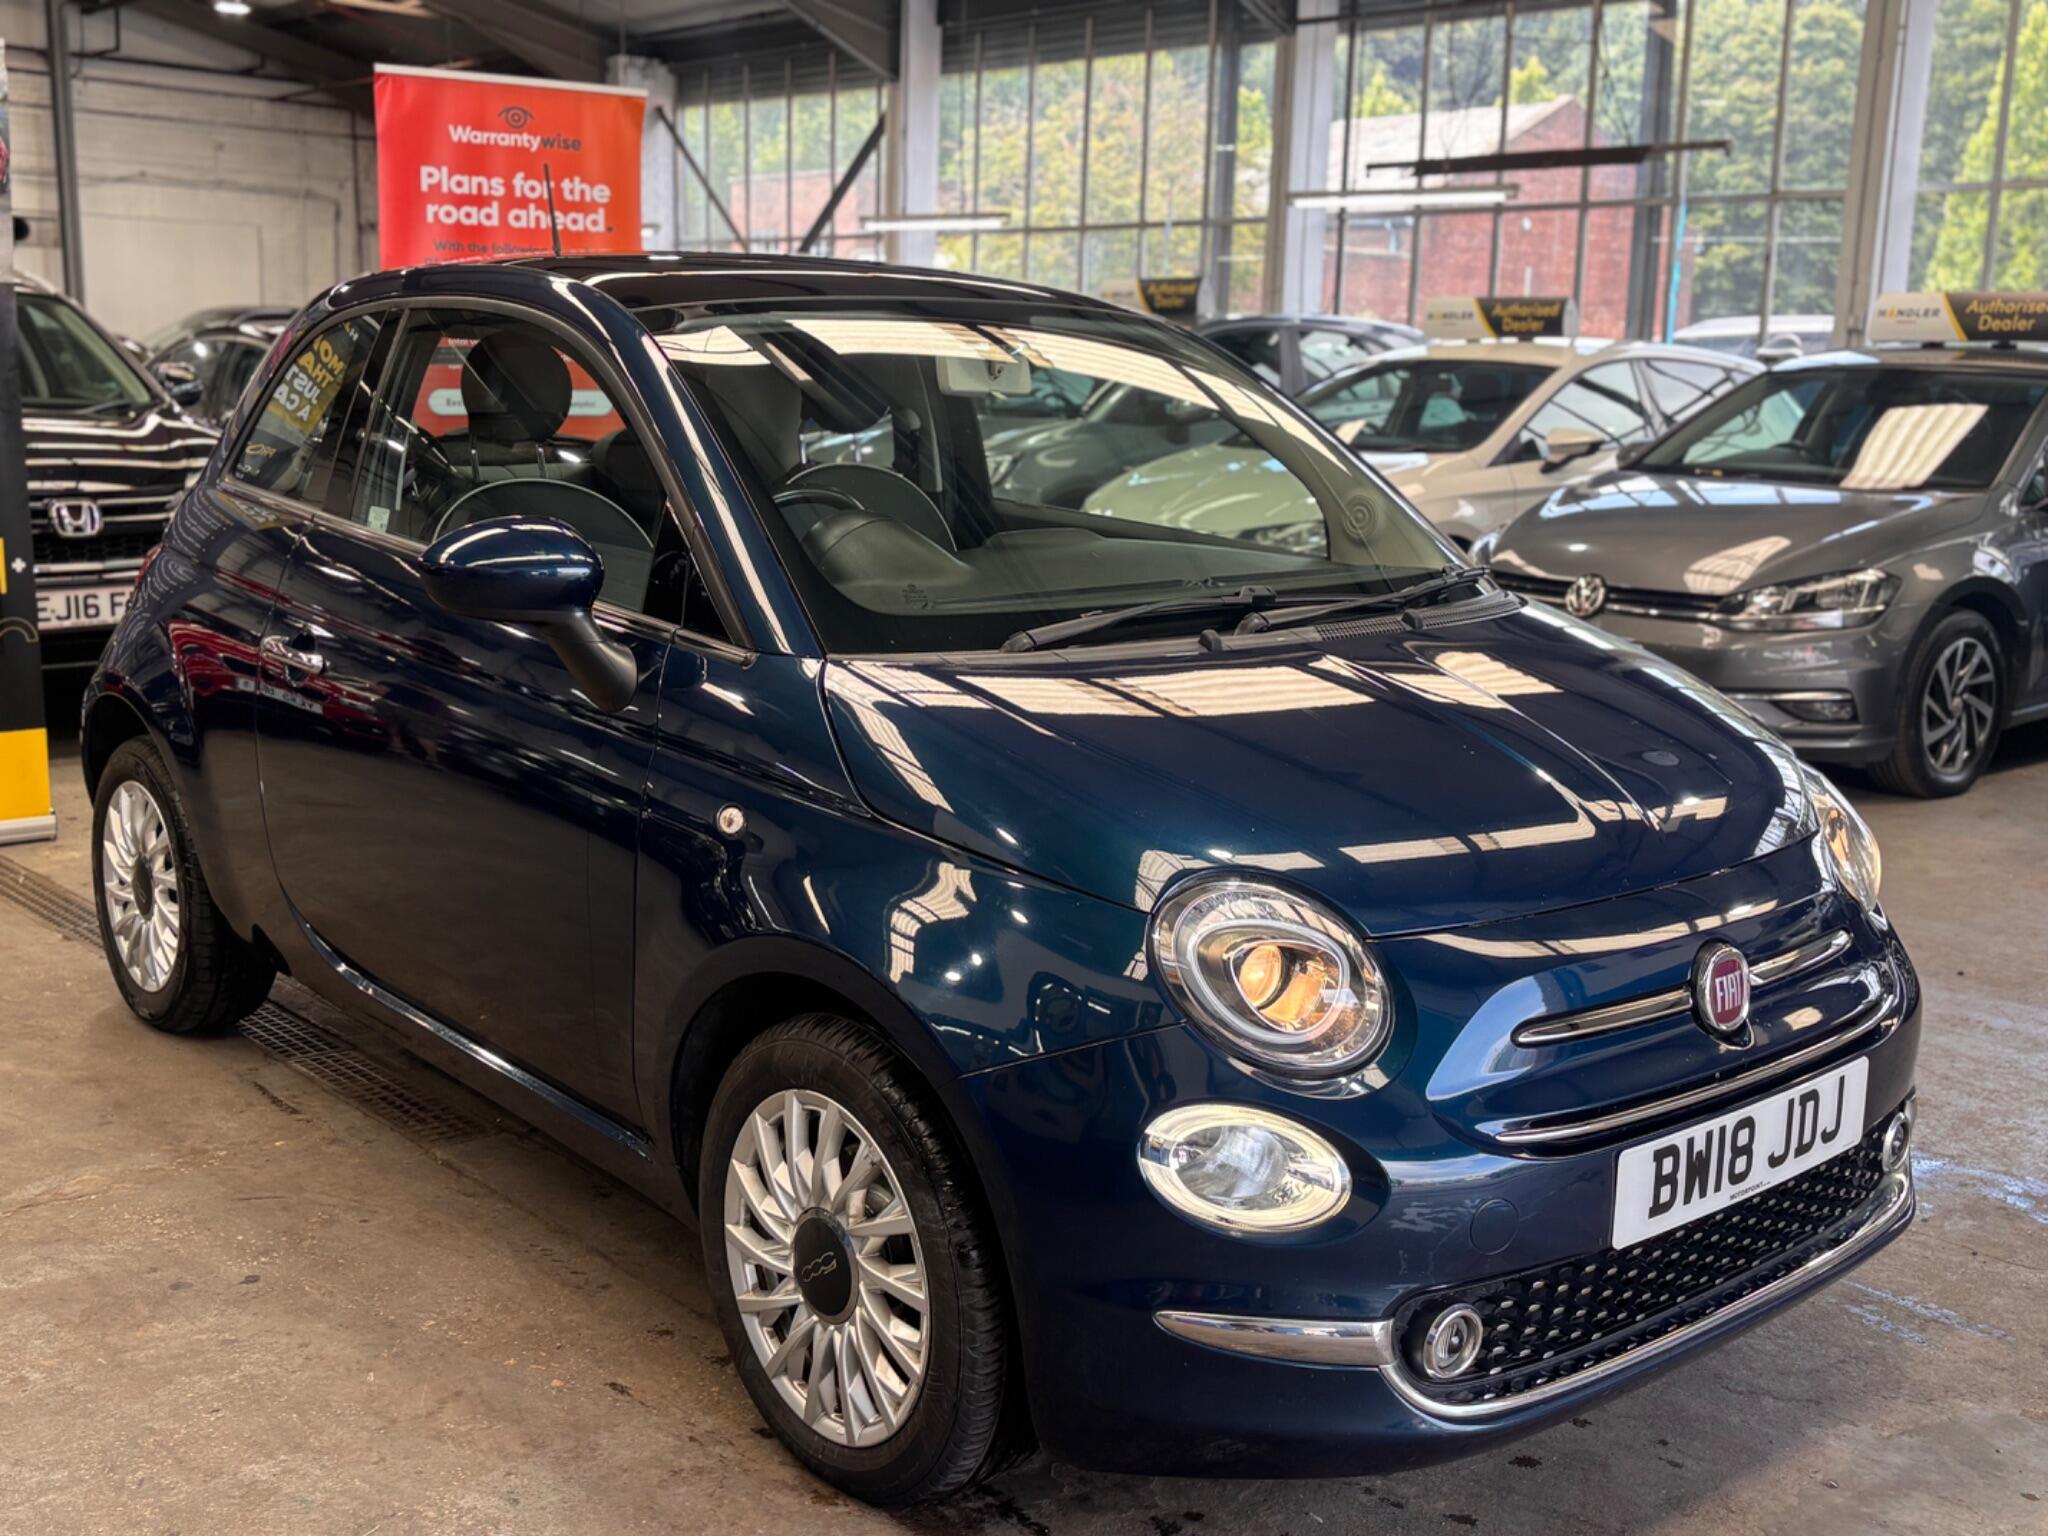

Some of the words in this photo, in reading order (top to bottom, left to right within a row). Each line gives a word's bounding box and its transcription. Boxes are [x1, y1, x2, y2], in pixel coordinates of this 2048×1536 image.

[449, 124, 582, 152] Warrantywise
[420, 165, 505, 197] Plans
[512, 172, 555, 200] for
[561, 177, 611, 204] the
[426, 201, 499, 227] road
[508, 205, 614, 233] ahead.
[1965, 297, 2048, 315] Authorise
[1978, 313, 2036, 333] Dealer
[1714, 970, 1741, 1013] FIAT
[1648, 1115, 1756, 1219] BW18
[1767, 1074, 1845, 1169] JDJ
